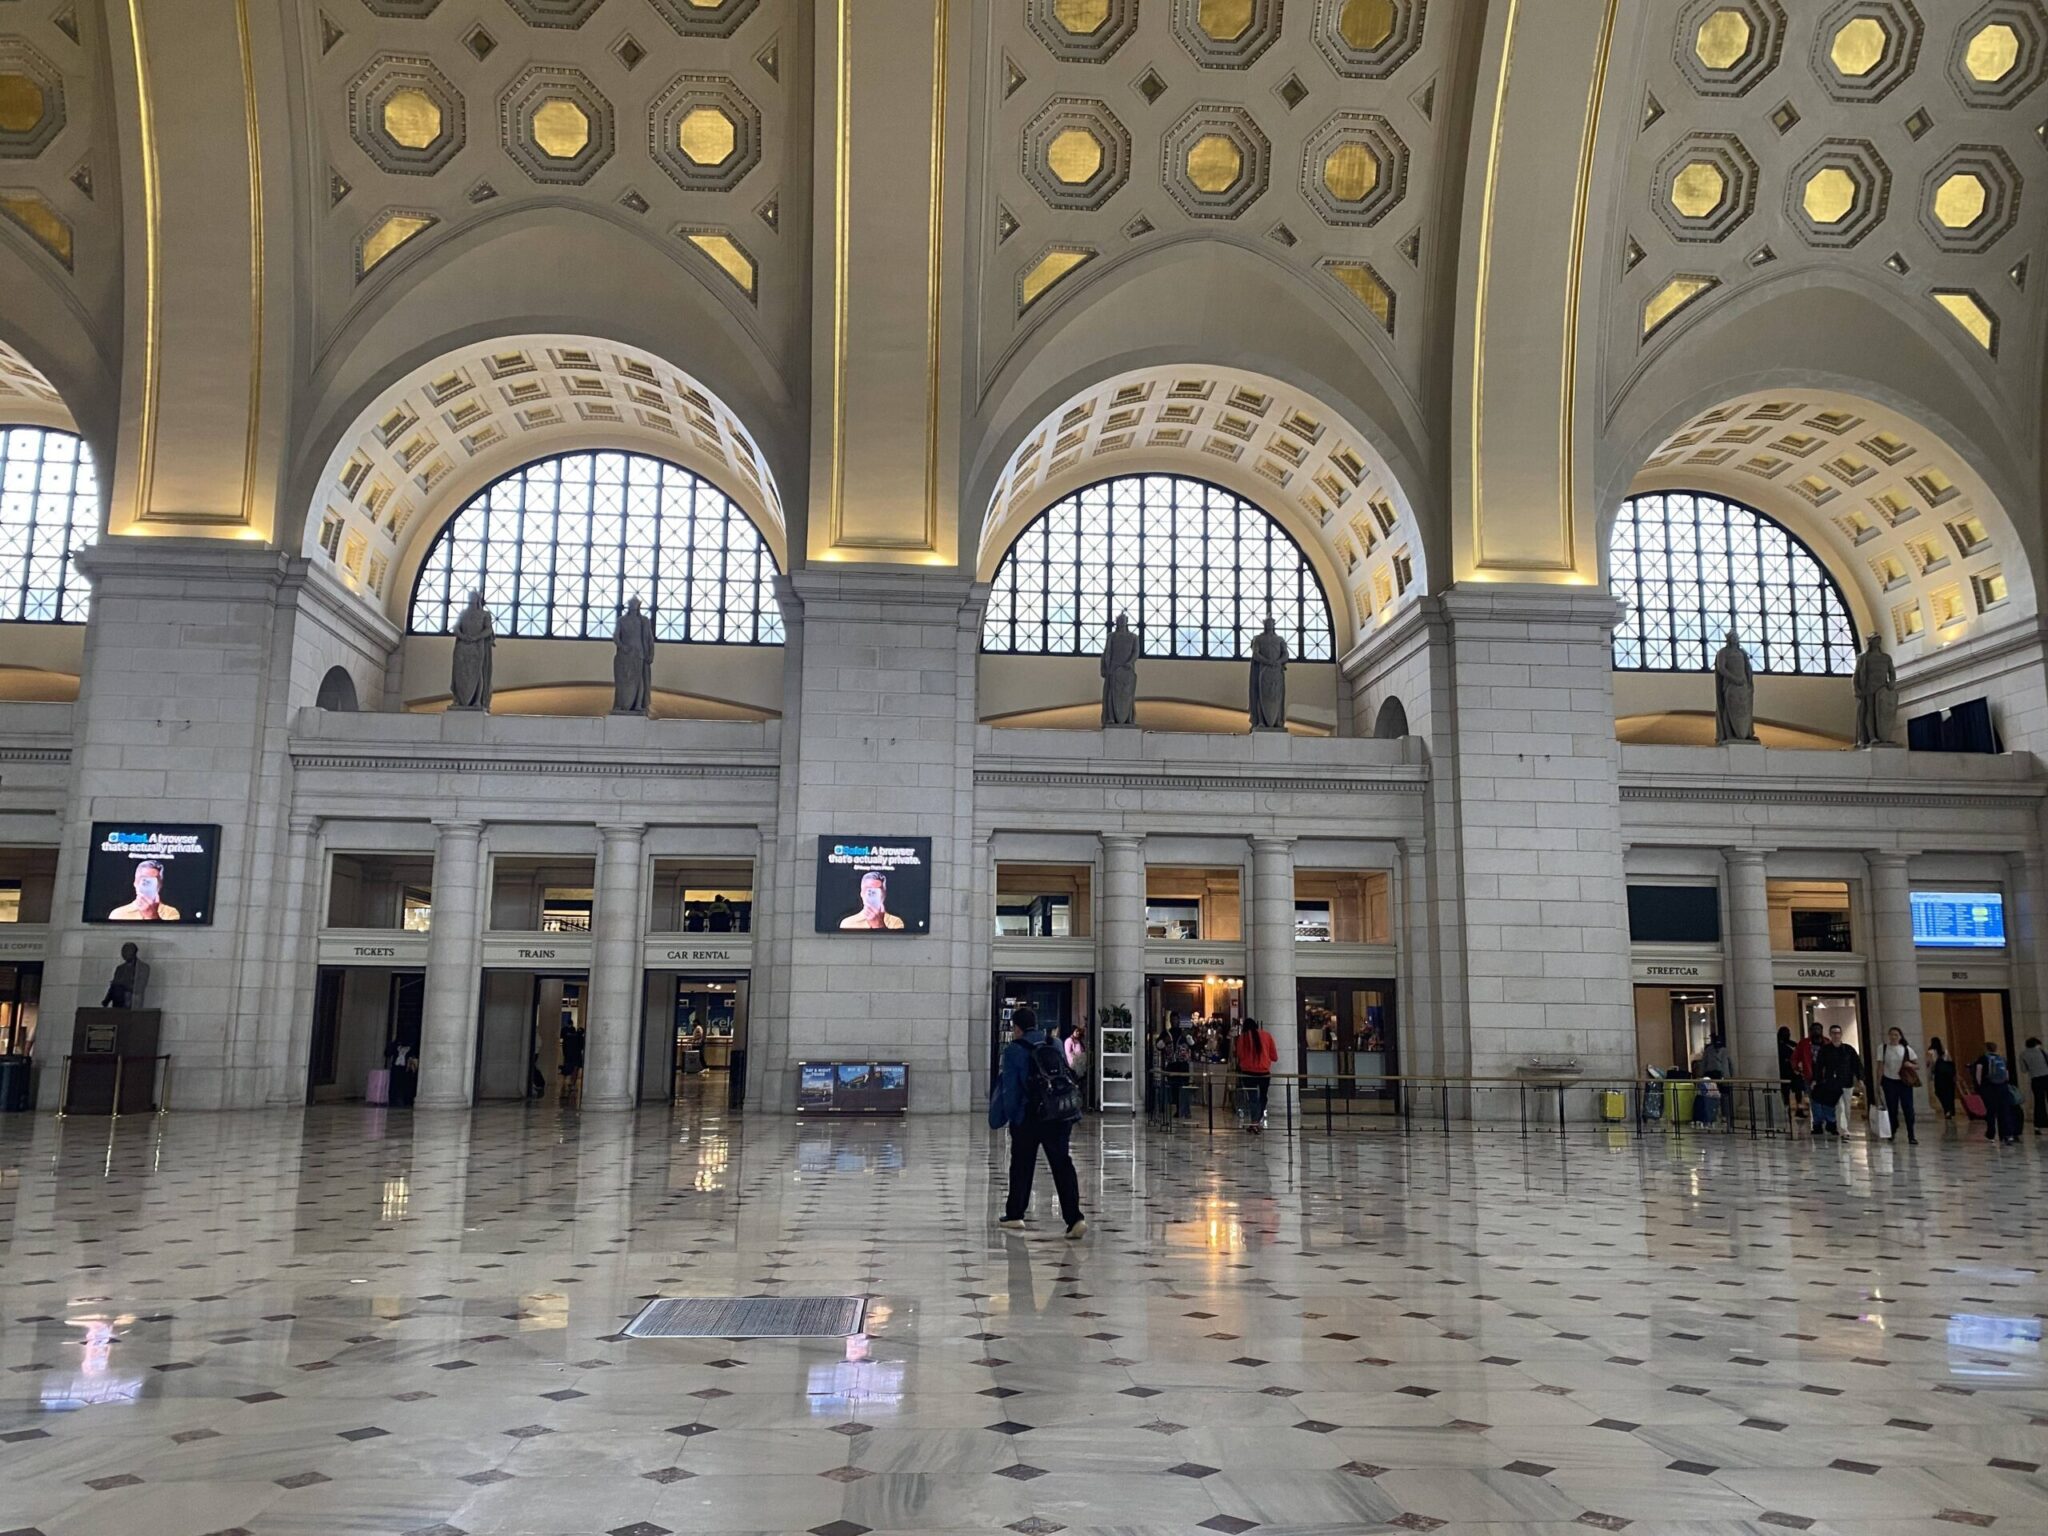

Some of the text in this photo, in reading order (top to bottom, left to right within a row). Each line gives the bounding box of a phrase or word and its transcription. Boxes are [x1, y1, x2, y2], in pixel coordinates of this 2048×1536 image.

[148, 833, 157, 843] A
[158, 833, 198, 843] browser
[101, 841, 204, 854] that's actually private.
[870, 846, 878, 855] A
[878, 846, 915, 856] browser
[828, 853, 921, 867] that's actually private.
[353, 947, 395, 957] TICKETS
[518, 949, 556, 959] TRAINS
[667, 951, 730, 960] CAR RENTAL
[1164, 957, 1225, 966] LEE'S FLOWERS
[1646, 966, 1699, 977] STREETCAR
[1797, 969, 1837, 978] GARAGE
[1952, 971, 1968, 980] BUS
